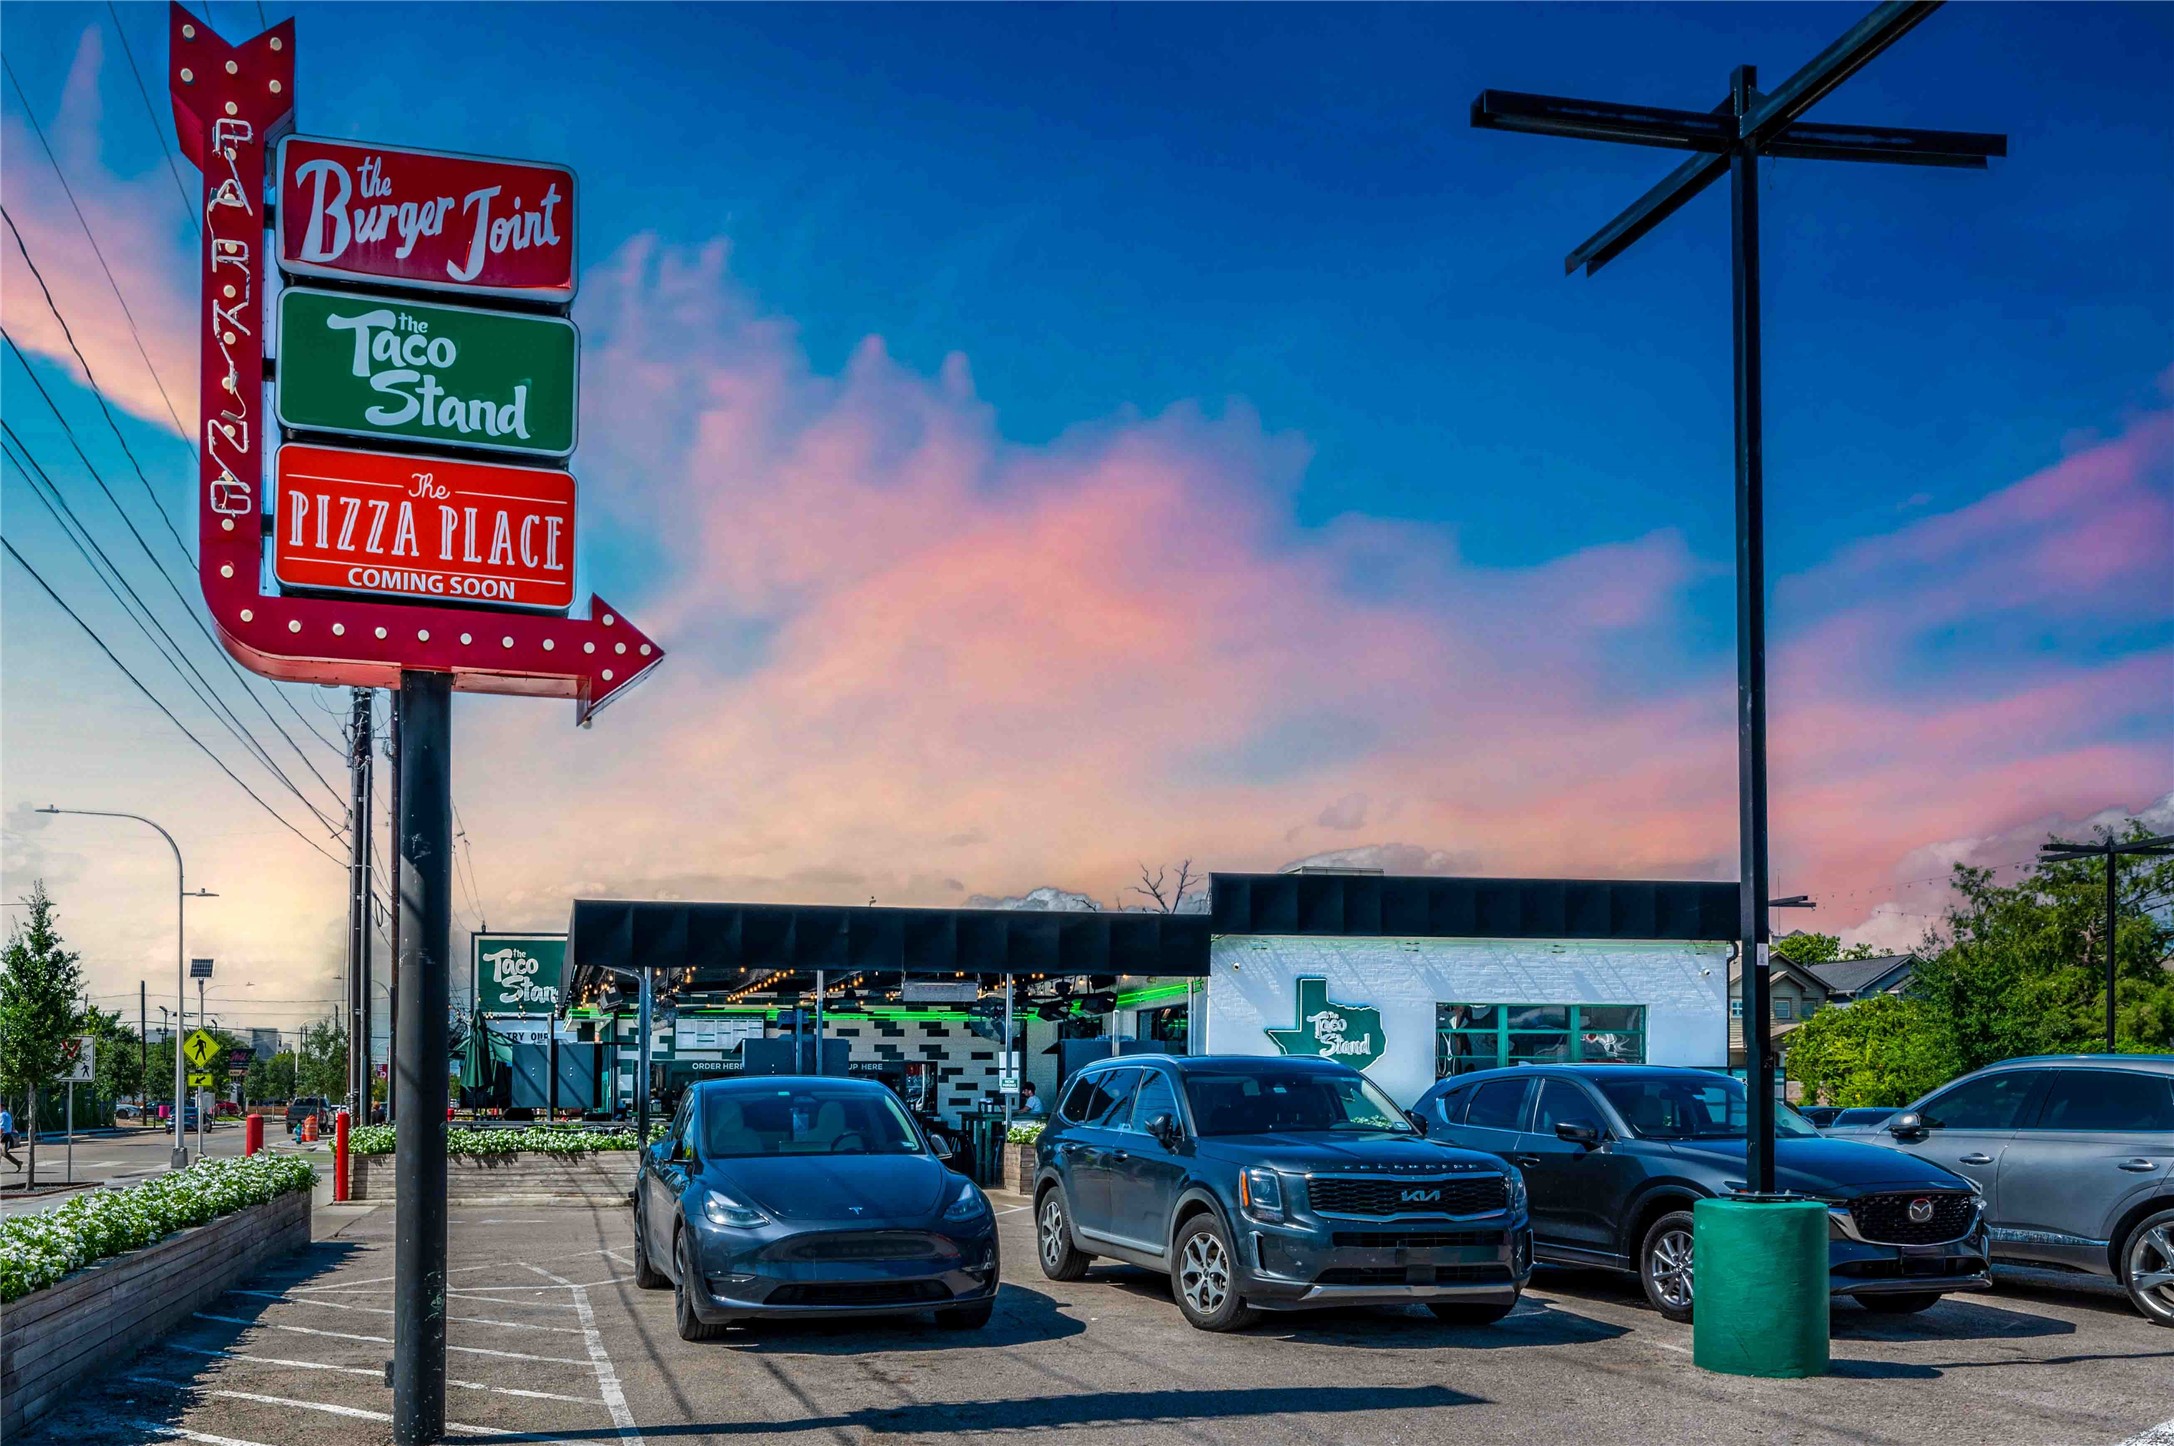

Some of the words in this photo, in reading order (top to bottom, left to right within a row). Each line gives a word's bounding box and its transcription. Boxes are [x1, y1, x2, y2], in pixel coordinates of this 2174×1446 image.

[356, 156, 392, 198] the
[295, 158, 455, 263] Burger
[446, 182, 562, 283] Joint
[208, 117, 254, 516] PARKING
[398, 312, 428, 334] the
[326, 309, 457, 378] Taco
[364, 369, 531, 440] Stand
[408, 473, 451, 500] The
[288, 490, 420, 557] PIZZA
[438, 505, 565, 571] PLACE
[347, 567, 444, 594] COMING
[450, 575, 516, 600] SOON
[482, 948, 539, 983] Taco
[512, 948, 527, 959] the
[499, 974, 559, 1004] Stan
[1306, 1011, 1348, 1039] Taco
[1319, 1033, 1371, 1057] Stand
[691, 1062, 722, 1070] ORDER
[861, 1063, 883, 1071] HERE
